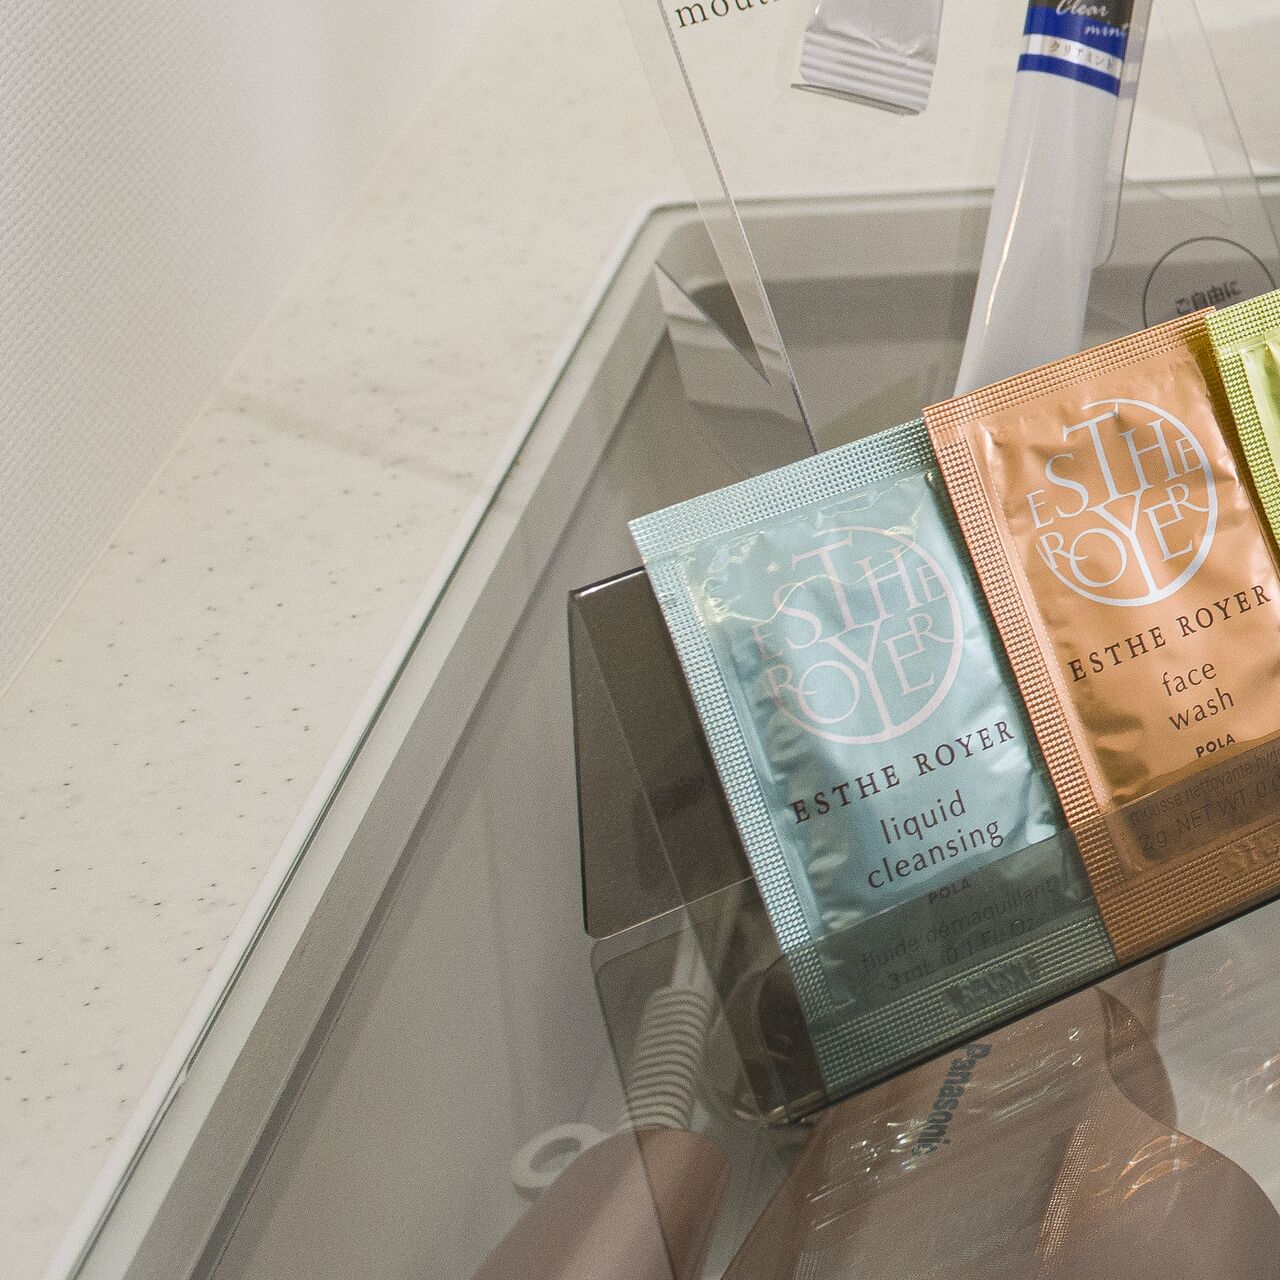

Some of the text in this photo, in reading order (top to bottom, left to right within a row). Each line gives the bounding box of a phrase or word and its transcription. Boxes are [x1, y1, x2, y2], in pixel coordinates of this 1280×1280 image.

[1026, 401, 1202, 530] ESTHE
[1035, 482, 1211, 598] ROYER
[753, 530, 950, 664] ESTHE
[1067, 583, 1272, 682] ESTHE ROYER
[766, 613, 952, 737] ROYER
[1162, 661, 1218, 697] face
[1168, 687, 1235, 731] wash
[790, 719, 1017, 825] ESTHE ROYER
[1195, 733, 1237, 759] POLA
[866, 819, 1005, 890] cleansing
[880, 789, 968, 845] liquid
[928, 878, 971, 905] POLA
